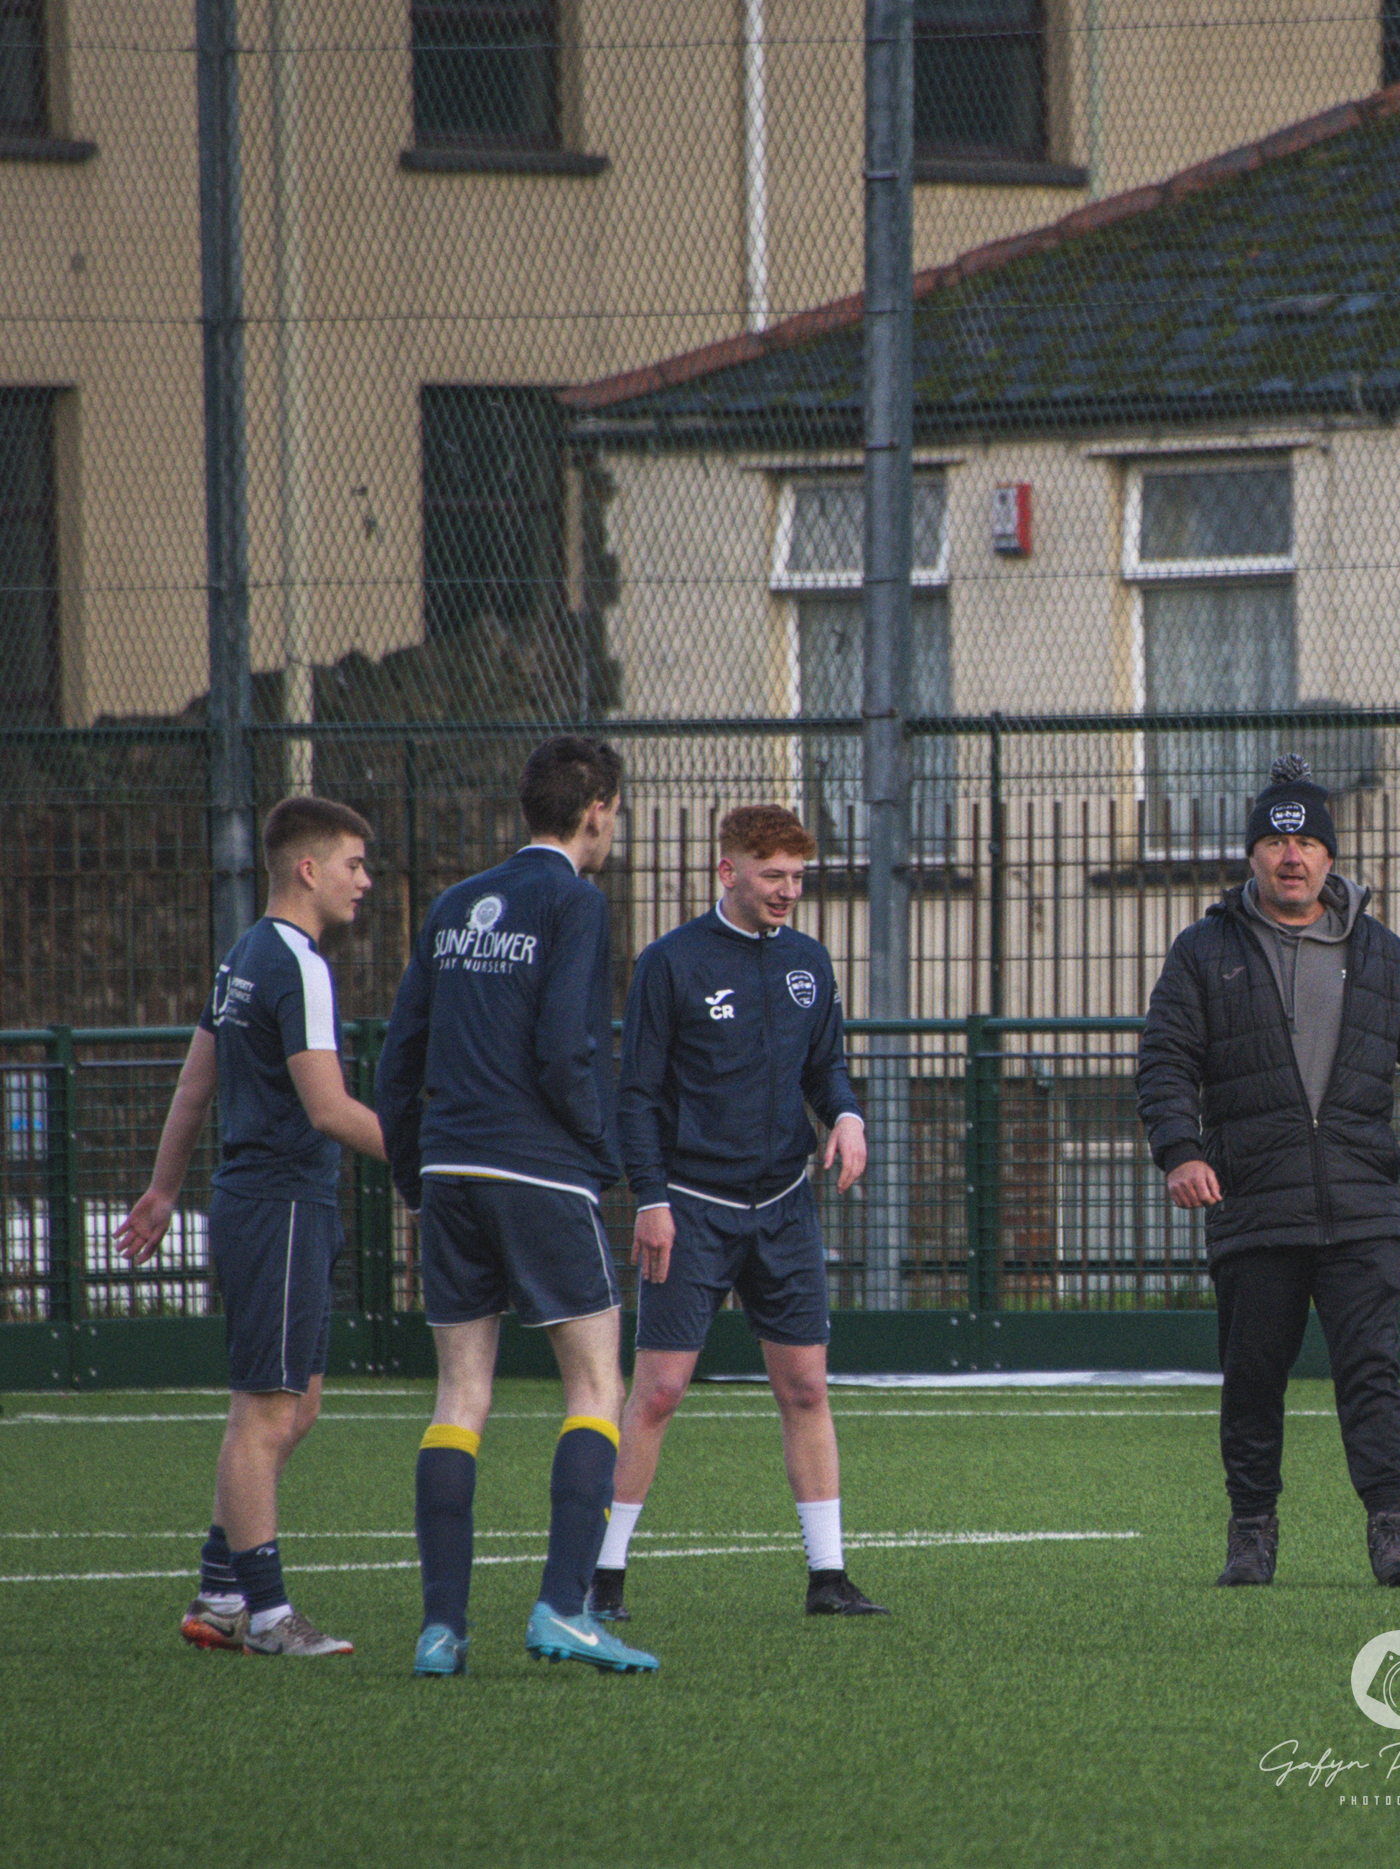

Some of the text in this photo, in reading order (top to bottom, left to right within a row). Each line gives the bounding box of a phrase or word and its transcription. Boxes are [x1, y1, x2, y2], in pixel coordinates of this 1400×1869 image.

[433, 928, 537, 964] SUNFLOWER
[462, 958, 513, 975] NURSERY
[709, 1004, 735, 1020] CR
